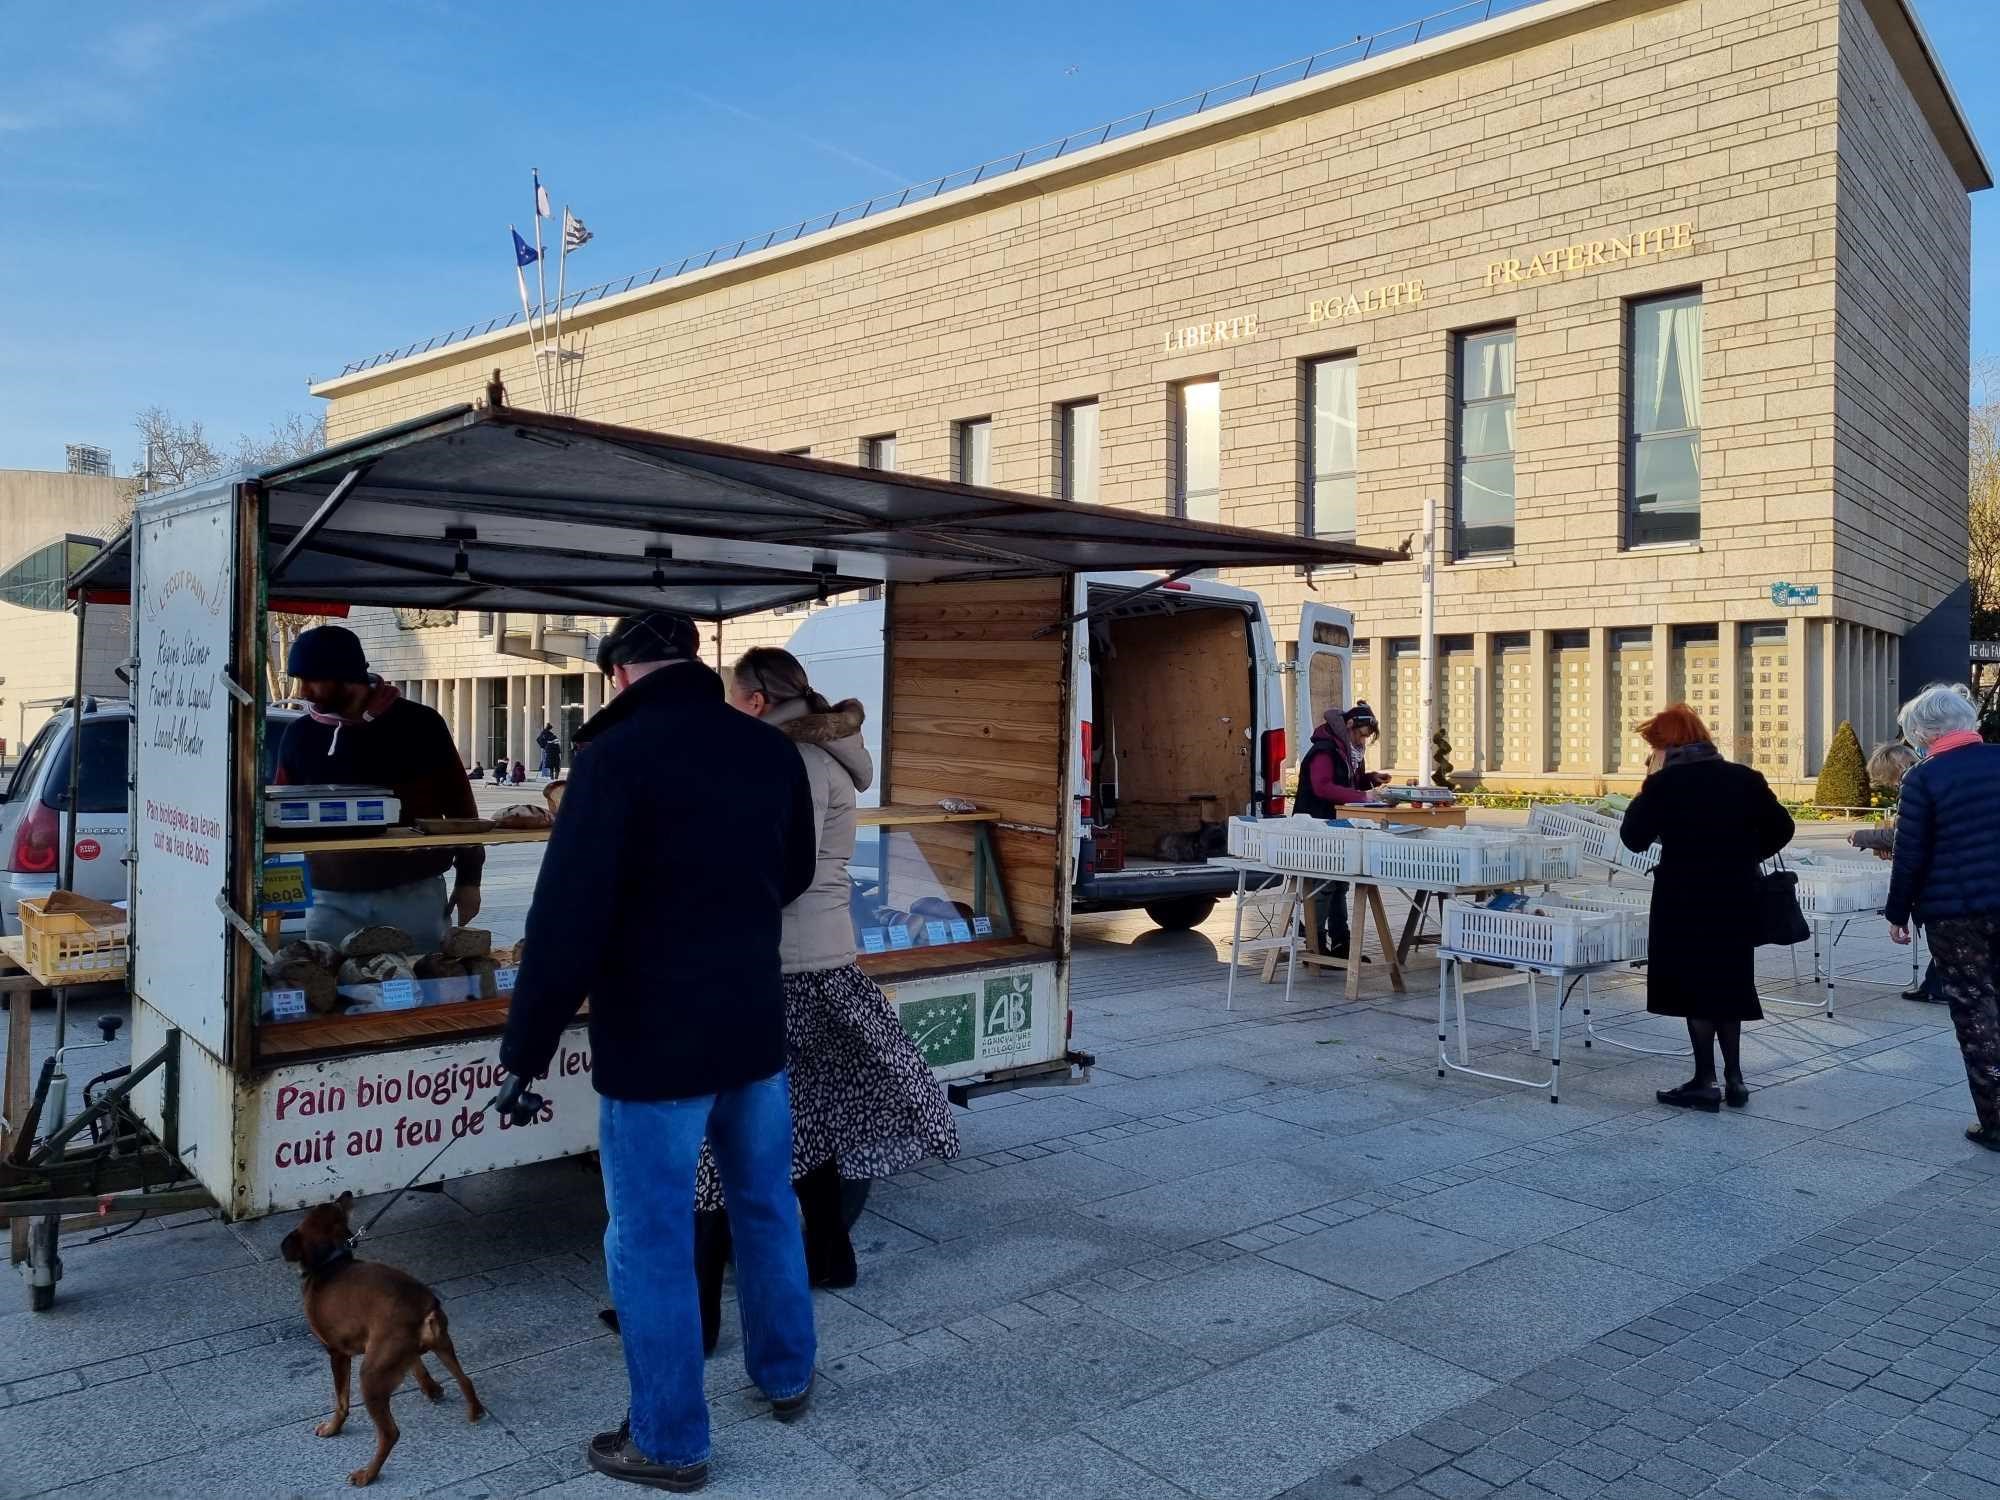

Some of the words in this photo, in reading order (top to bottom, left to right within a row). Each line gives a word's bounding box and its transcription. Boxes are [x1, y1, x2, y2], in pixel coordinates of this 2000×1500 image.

[1164, 313, 1259, 352] LIBERTE
[1308, 279, 1424, 323] EGALITE
[1486, 221, 1695, 287] FRATERNITE
[1979, 643, 1990, 657] du
[176, 674, 185, 707] de
[146, 800, 159, 821] Pain
[160, 802, 189, 832] biologique
[190, 815, 199, 834] au
[200, 814, 221, 841] levain
[153, 832, 165, 849] cuit
[173, 835, 185, 857] feu
[185, 840, 194, 861] de
[195, 842, 209, 867] bois
[988, 992, 1026, 1034] AB
[276, 1081, 346, 1121] Pain
[357, 1063, 508, 1108] biologique
[275, 1130, 336, 1168] cuit
[346, 1128, 383, 1157] au
[394, 1116, 442, 1149] feu
[451, 1106, 485, 1138] de
